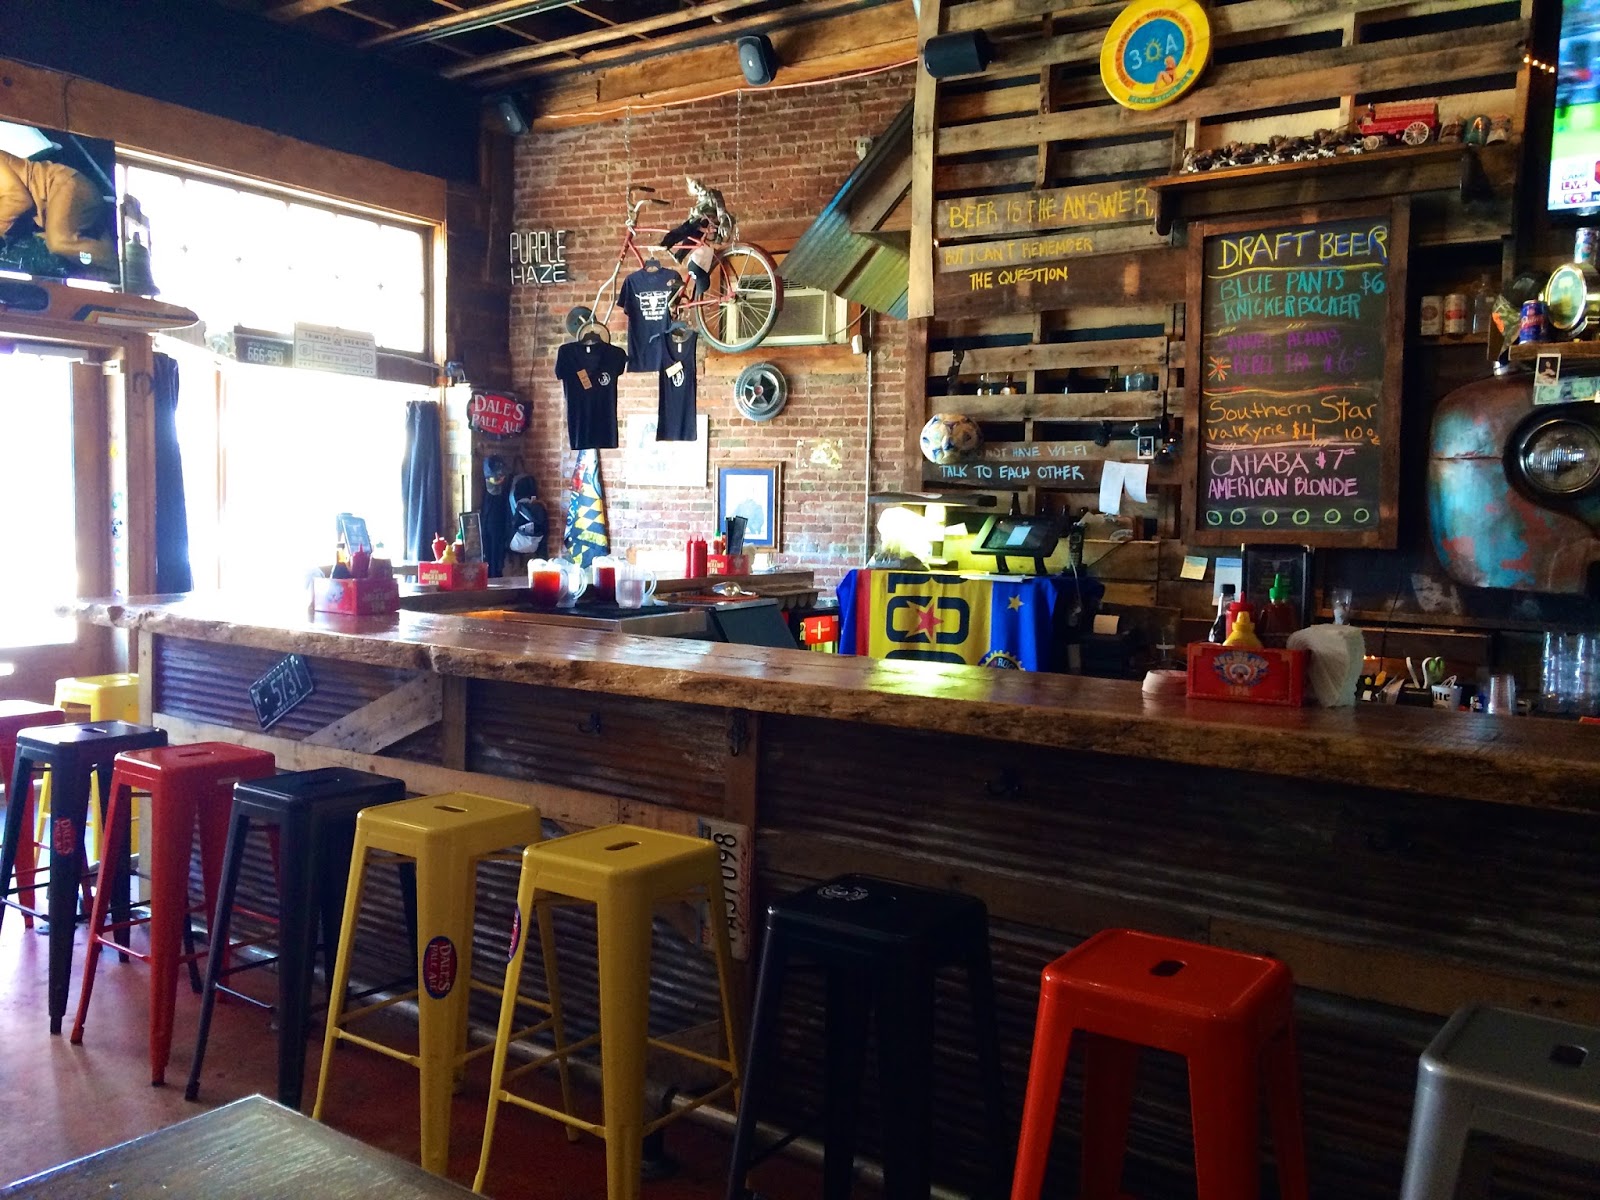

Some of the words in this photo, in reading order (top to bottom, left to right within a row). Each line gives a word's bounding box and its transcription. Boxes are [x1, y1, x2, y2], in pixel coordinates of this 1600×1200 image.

[950, 203, 997, 228] BEER
[1007, 202, 1022, 221] IS
[1028, 198, 1057, 223] THE
[510, 230, 566, 264] PURPLE
[1022, 237, 1093, 259] REMEMBER
[1217, 229, 1316, 270] DRAFT
[1318, 225, 1388, 264] BEER
[510, 263, 567, 285] HAZE
[969, 271, 993, 290] THE
[998, 266, 1068, 286] QUESTION
[1220, 272, 1275, 300] BLUE
[1286, 269, 1345, 294] PANTS
[1360, 271, 1386, 296] $6
[1220, 293, 1361, 324] KNICKERBOCKER
[474, 394, 525, 421] DALE'S
[1206, 399, 1312, 424] Southern
[1312, 395, 1377, 424] Star
[471, 413, 498, 428] PALE
[501, 420, 521, 434] ALE
[1012, 446, 1041, 458] HAVE
[1211, 450, 1310, 477] CAHABA
[939, 463, 969, 479] TALK
[973, 464, 993, 479] TO
[999, 465, 1031, 481] EACH
[1037, 465, 1085, 481] OTHER
[1208, 477, 1288, 499] AMERICAN
[1295, 476, 1358, 498] BLONDE
